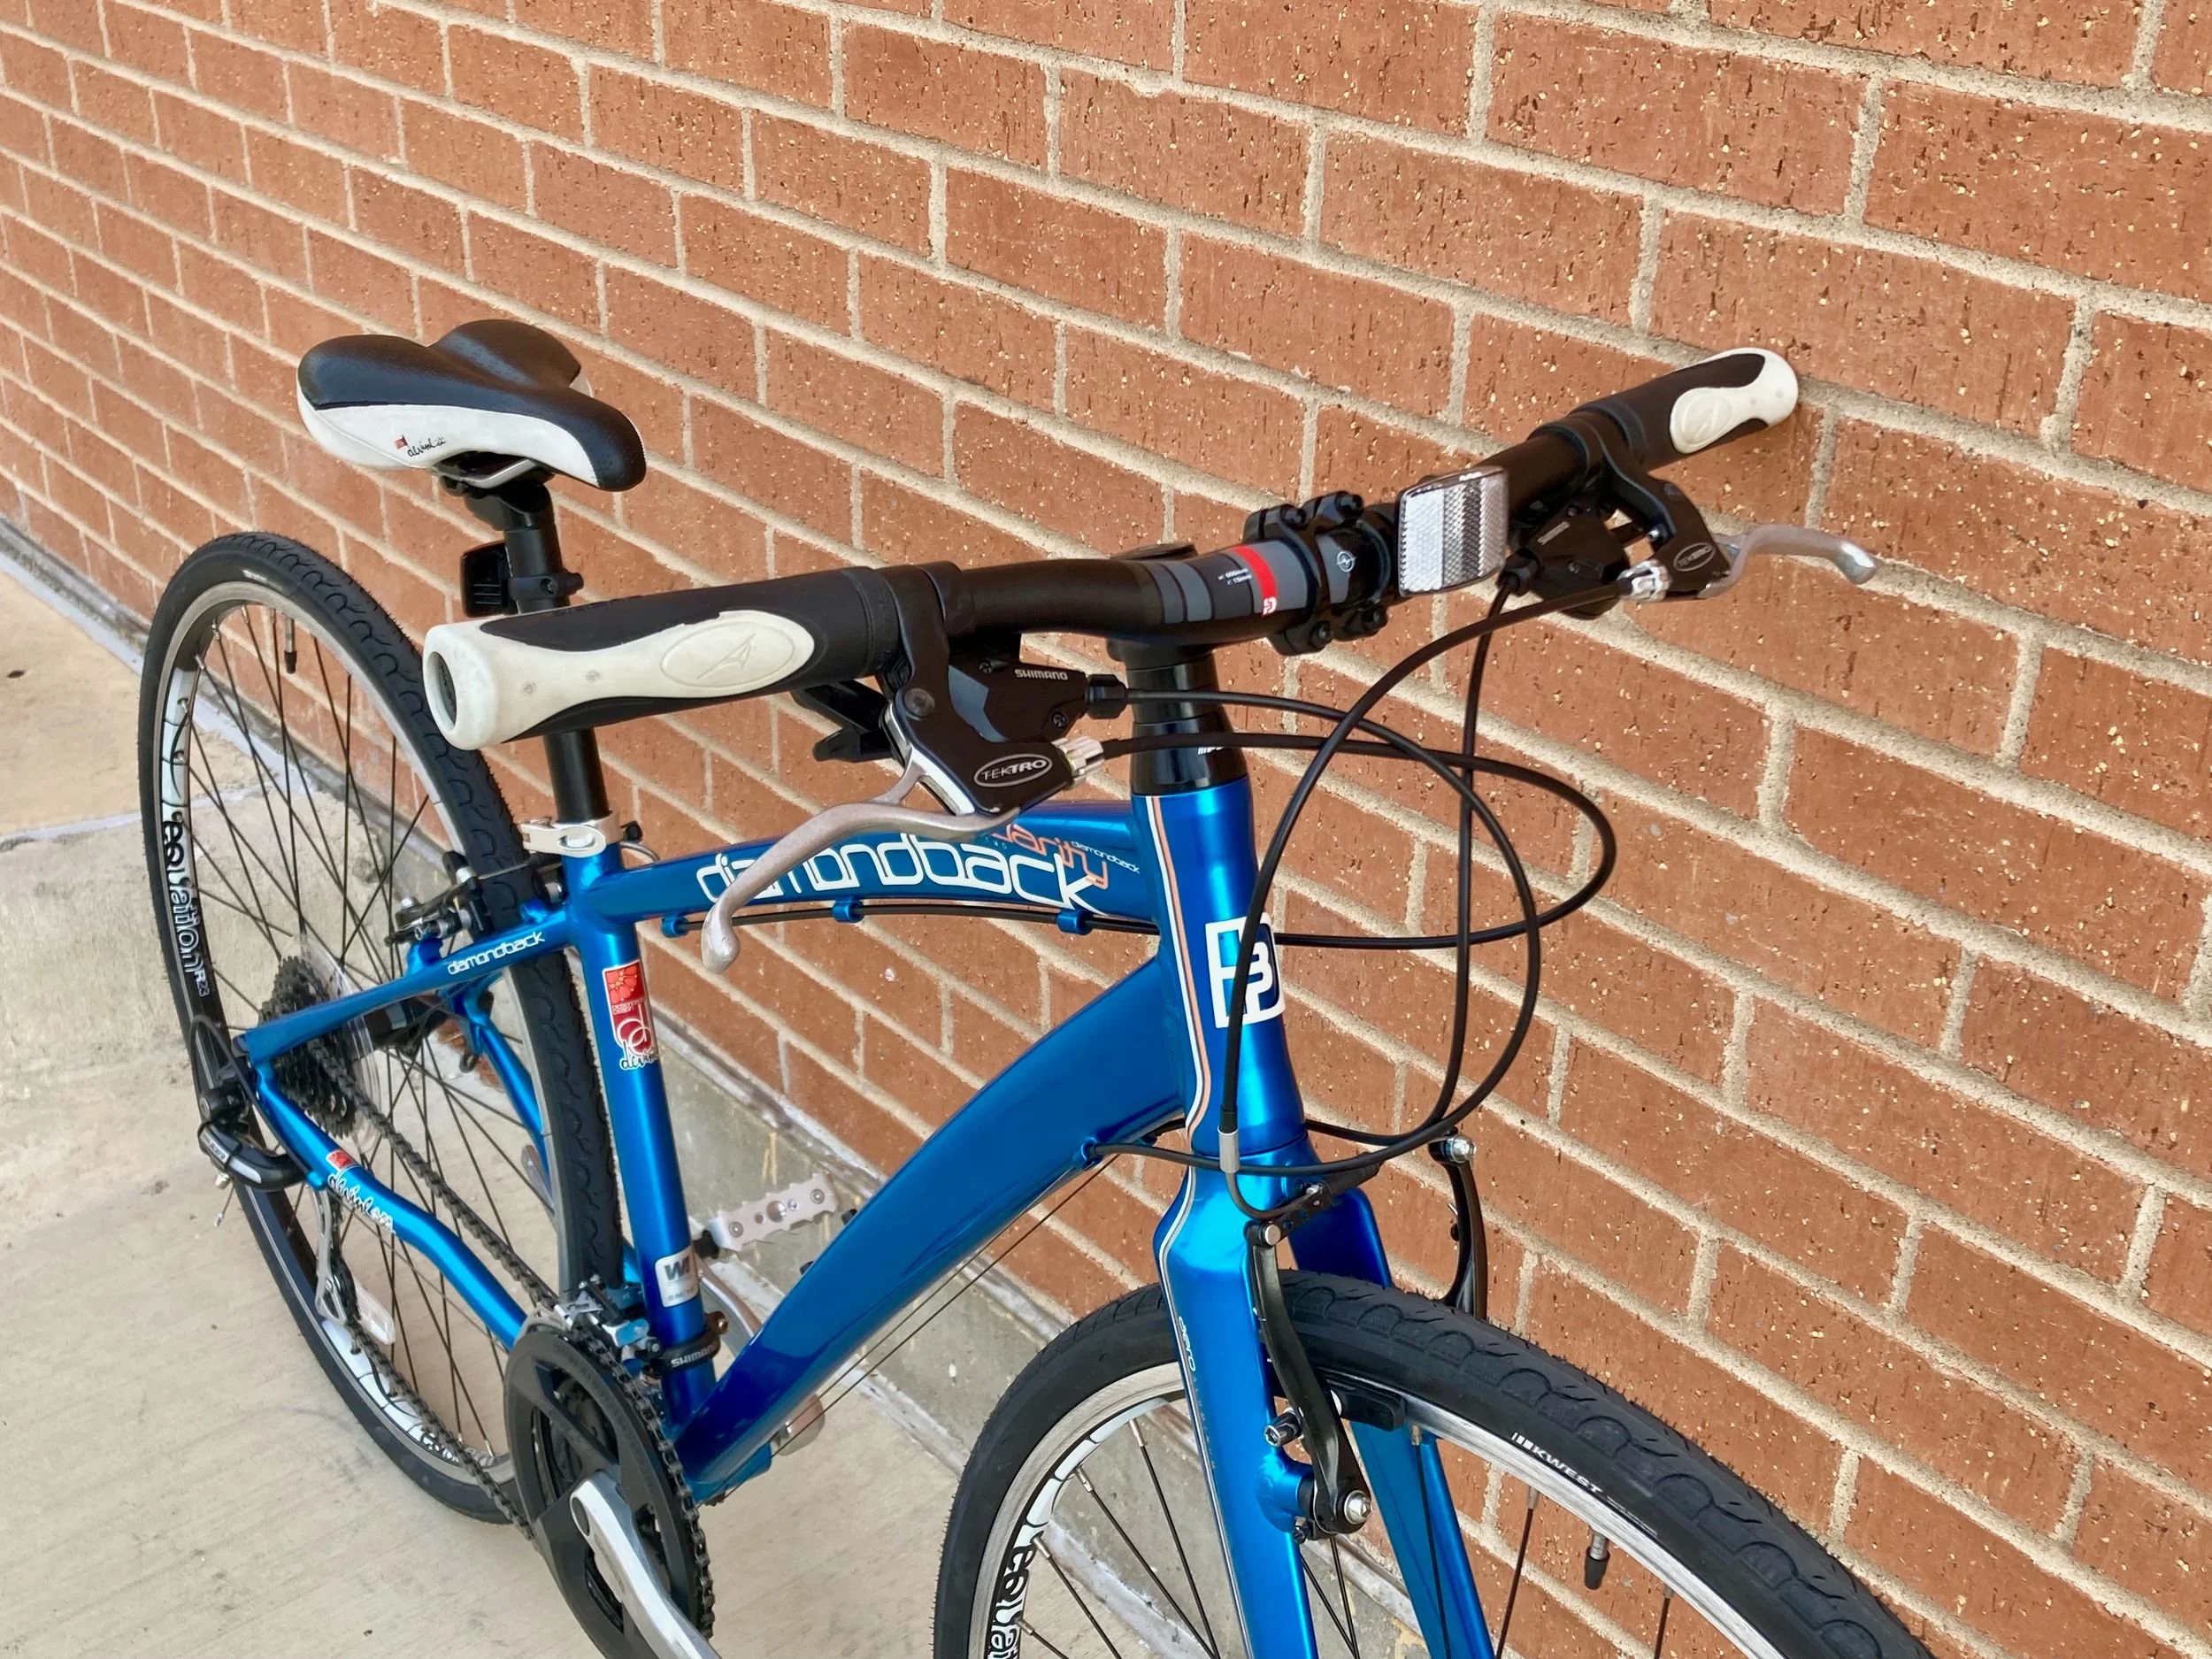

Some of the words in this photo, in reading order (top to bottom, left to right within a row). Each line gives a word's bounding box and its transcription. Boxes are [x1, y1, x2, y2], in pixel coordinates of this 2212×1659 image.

[1014, 668, 1069, 680] SHIMANO
[980, 758, 1048, 781] TEKTRO
[1532, 1444, 1604, 1494] KWEST
